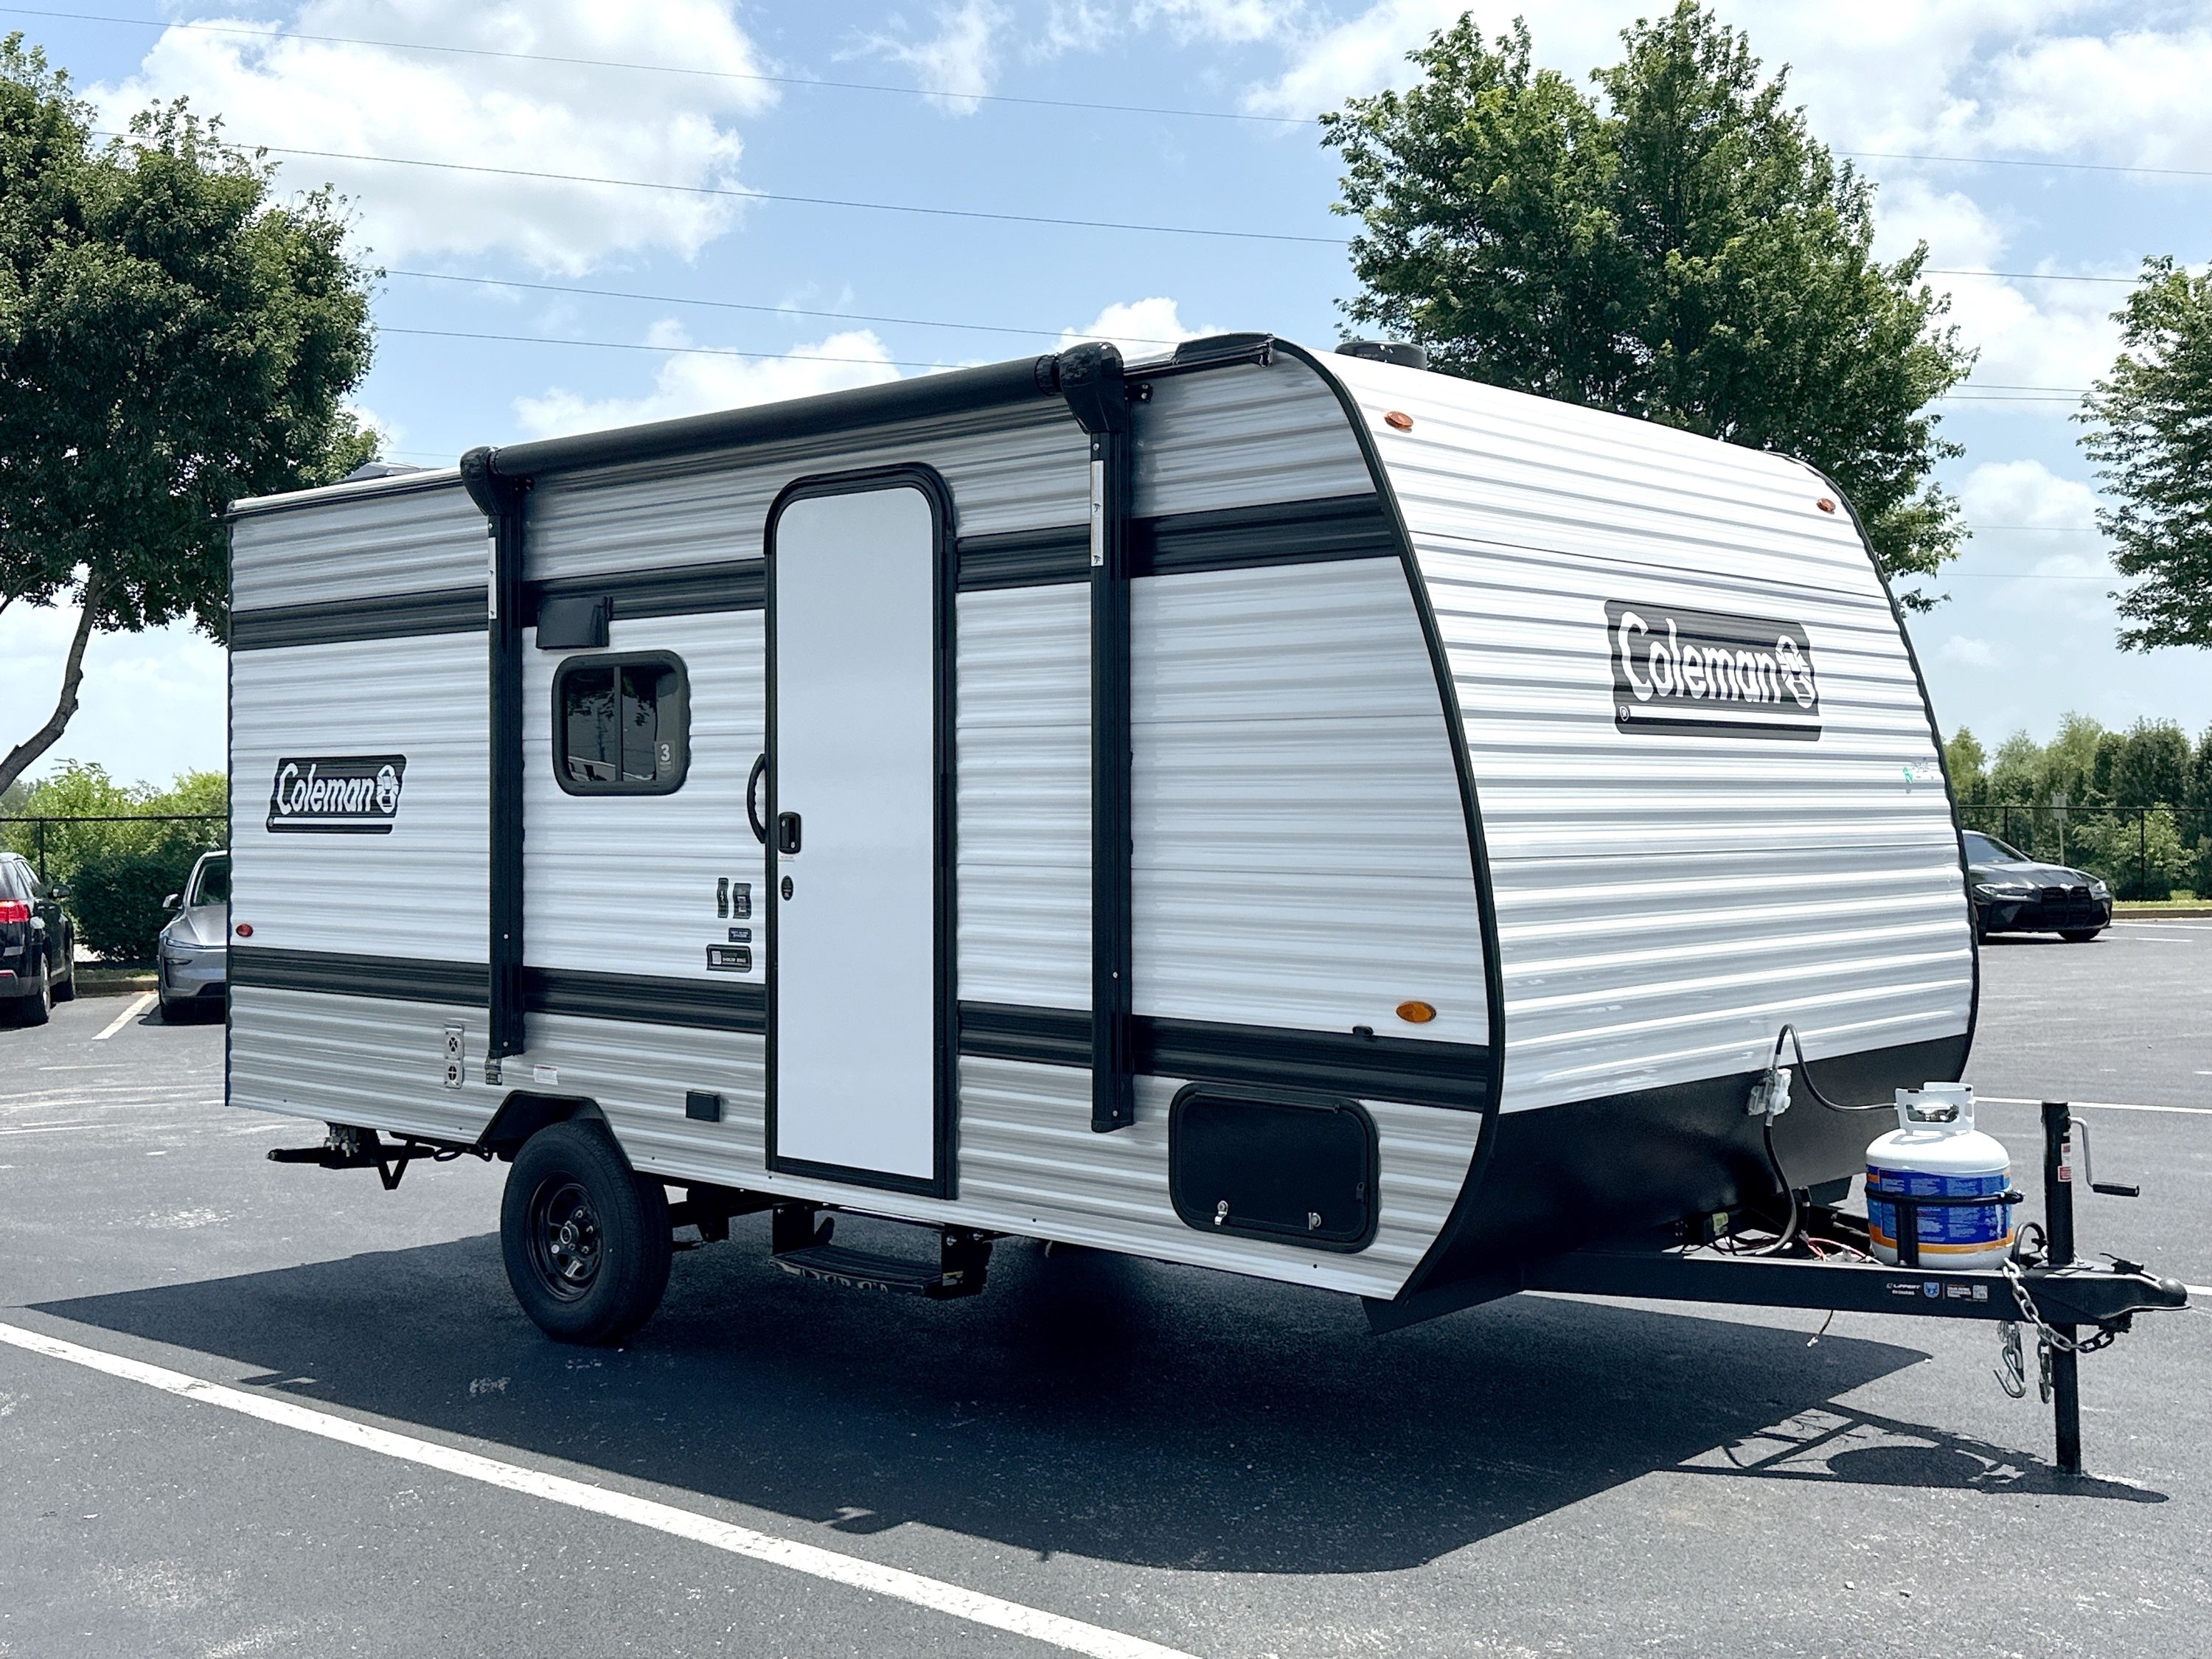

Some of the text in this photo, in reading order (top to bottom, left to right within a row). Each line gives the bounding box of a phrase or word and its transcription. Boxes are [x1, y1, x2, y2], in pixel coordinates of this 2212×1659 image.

[1618, 611, 1781, 703] Coleman
[661, 743, 669, 761] 3
[276, 762, 375, 815] Coleman
